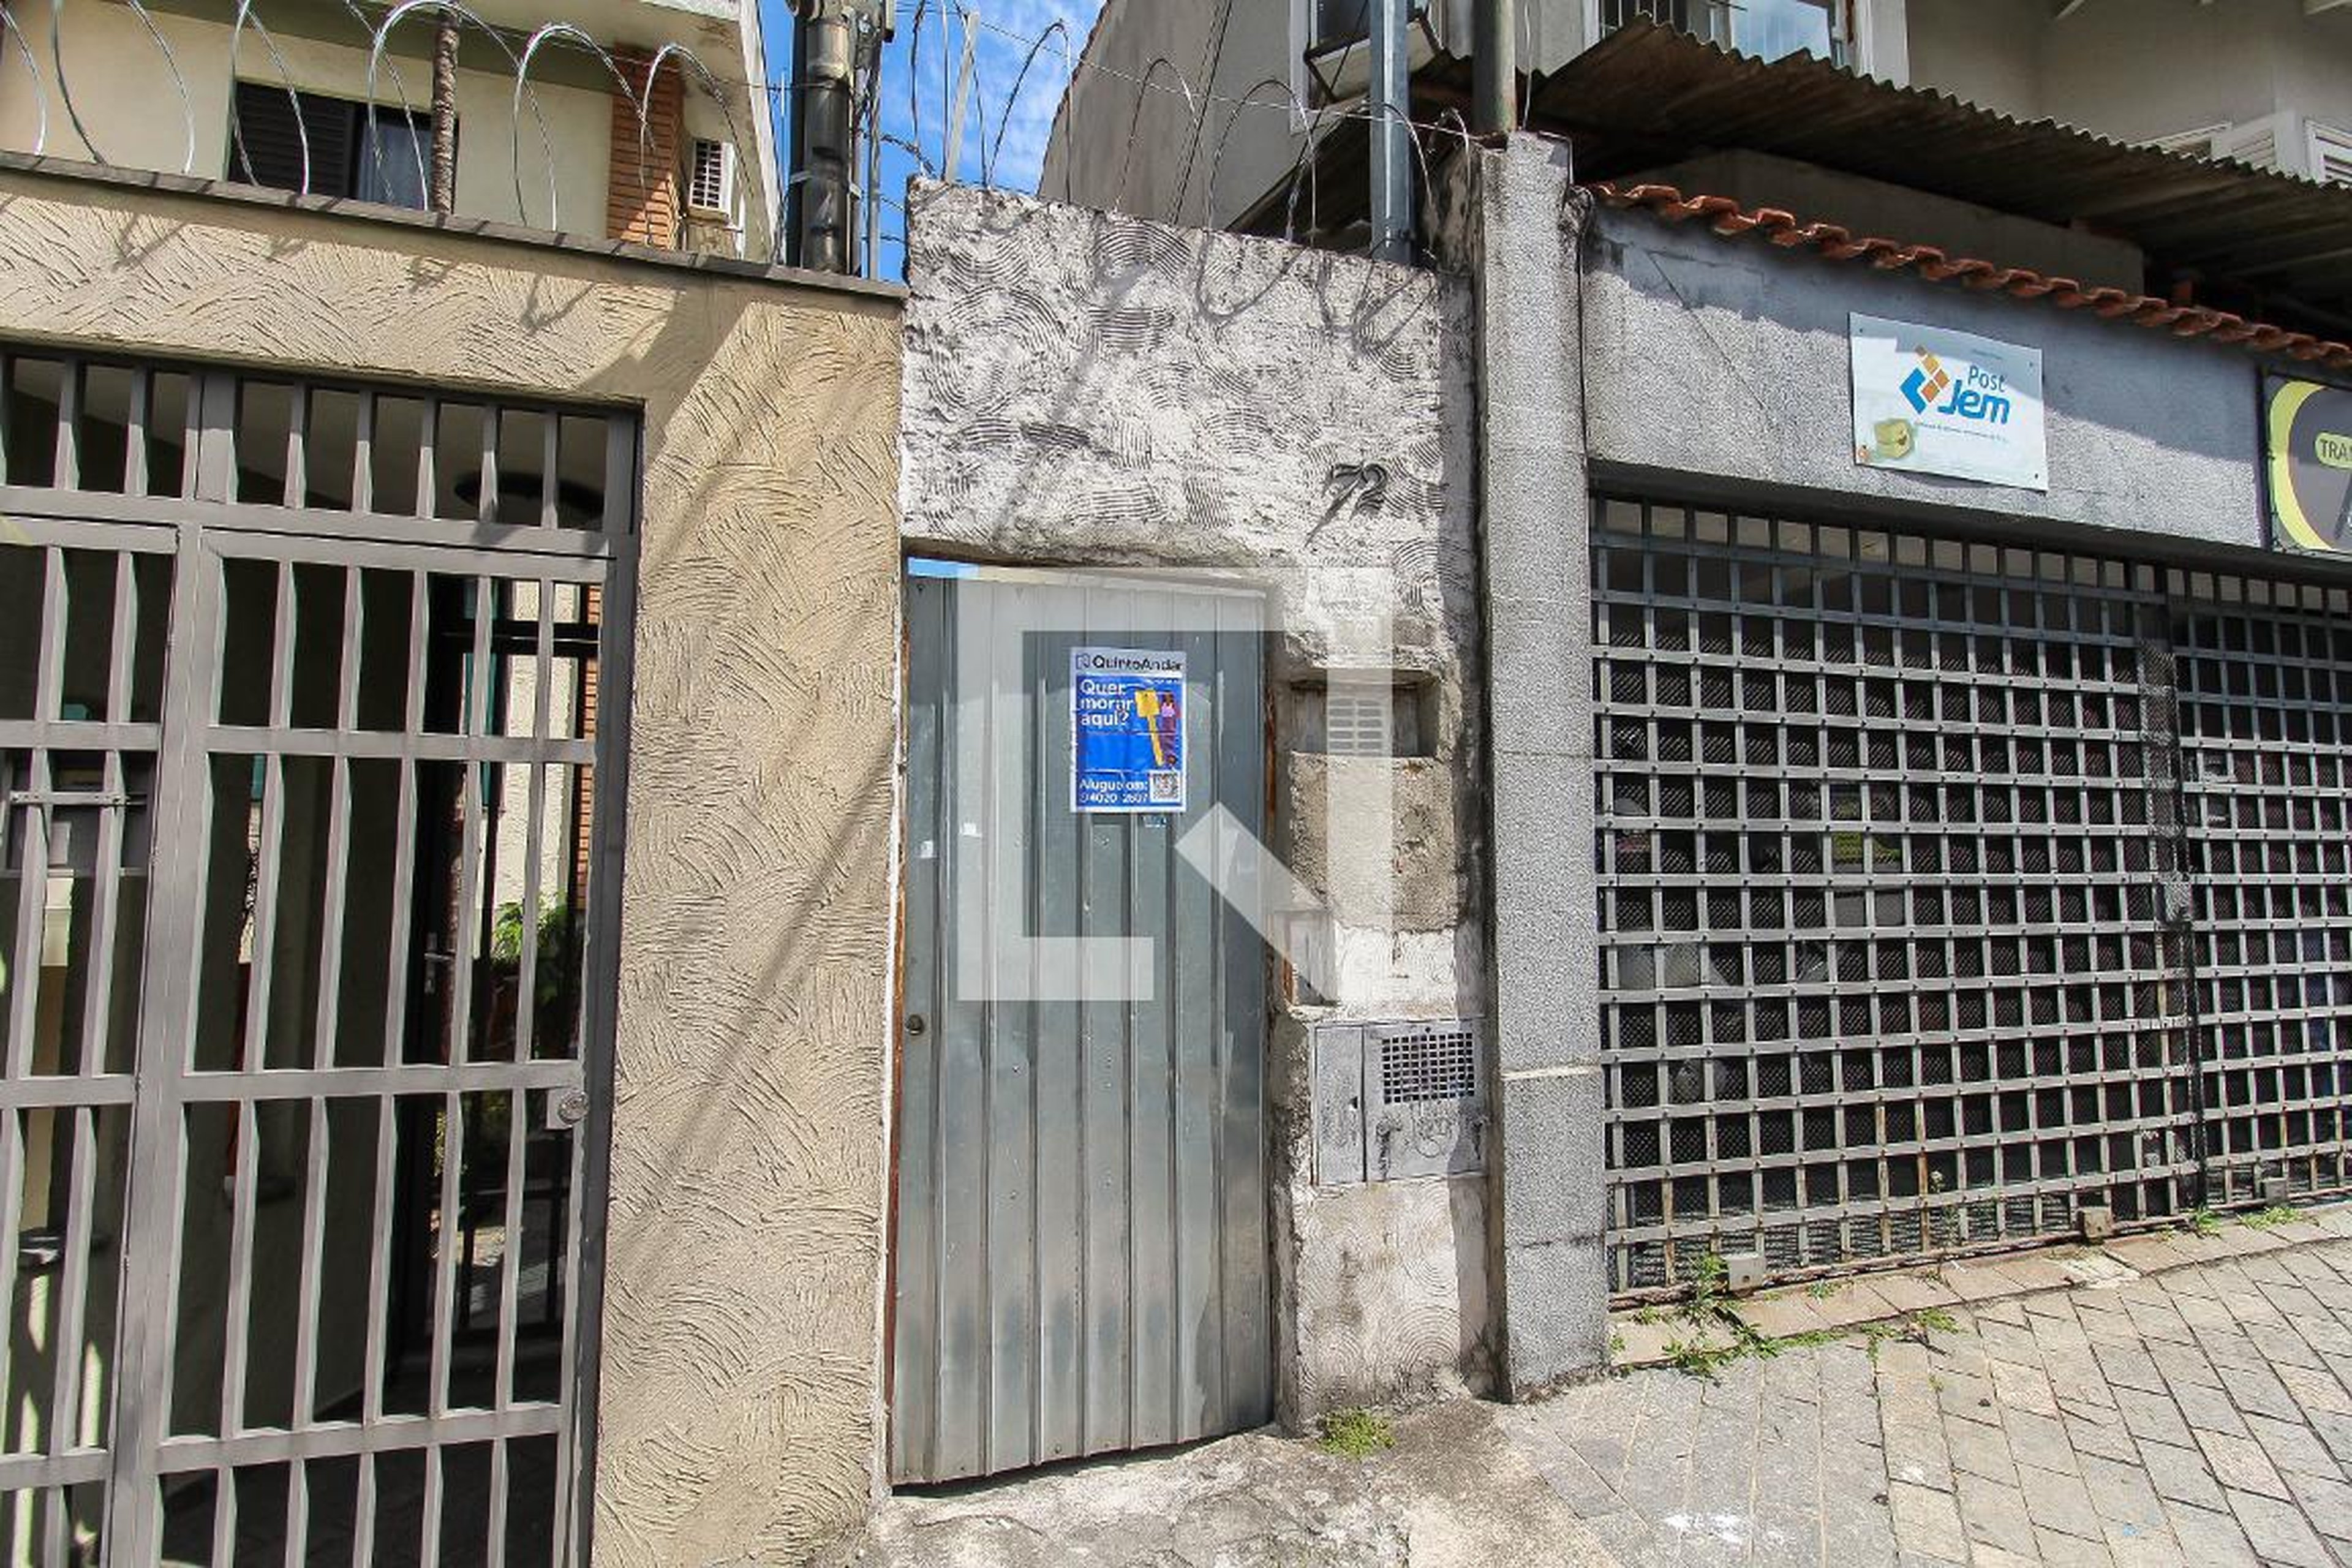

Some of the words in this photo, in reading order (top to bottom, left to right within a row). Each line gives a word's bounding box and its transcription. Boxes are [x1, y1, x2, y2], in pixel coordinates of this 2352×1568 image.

[1967, 364, 2008, 393] Post
[1937, 379, 2010, 424] Jem
[2320, 439, 2352, 461] TRA
[1091, 655, 1182, 671] QuintoAndar
[1080, 679, 1127, 695] Quer
[1080, 698, 1134, 710] morar
[1081, 710, 1129, 727] aqui?
